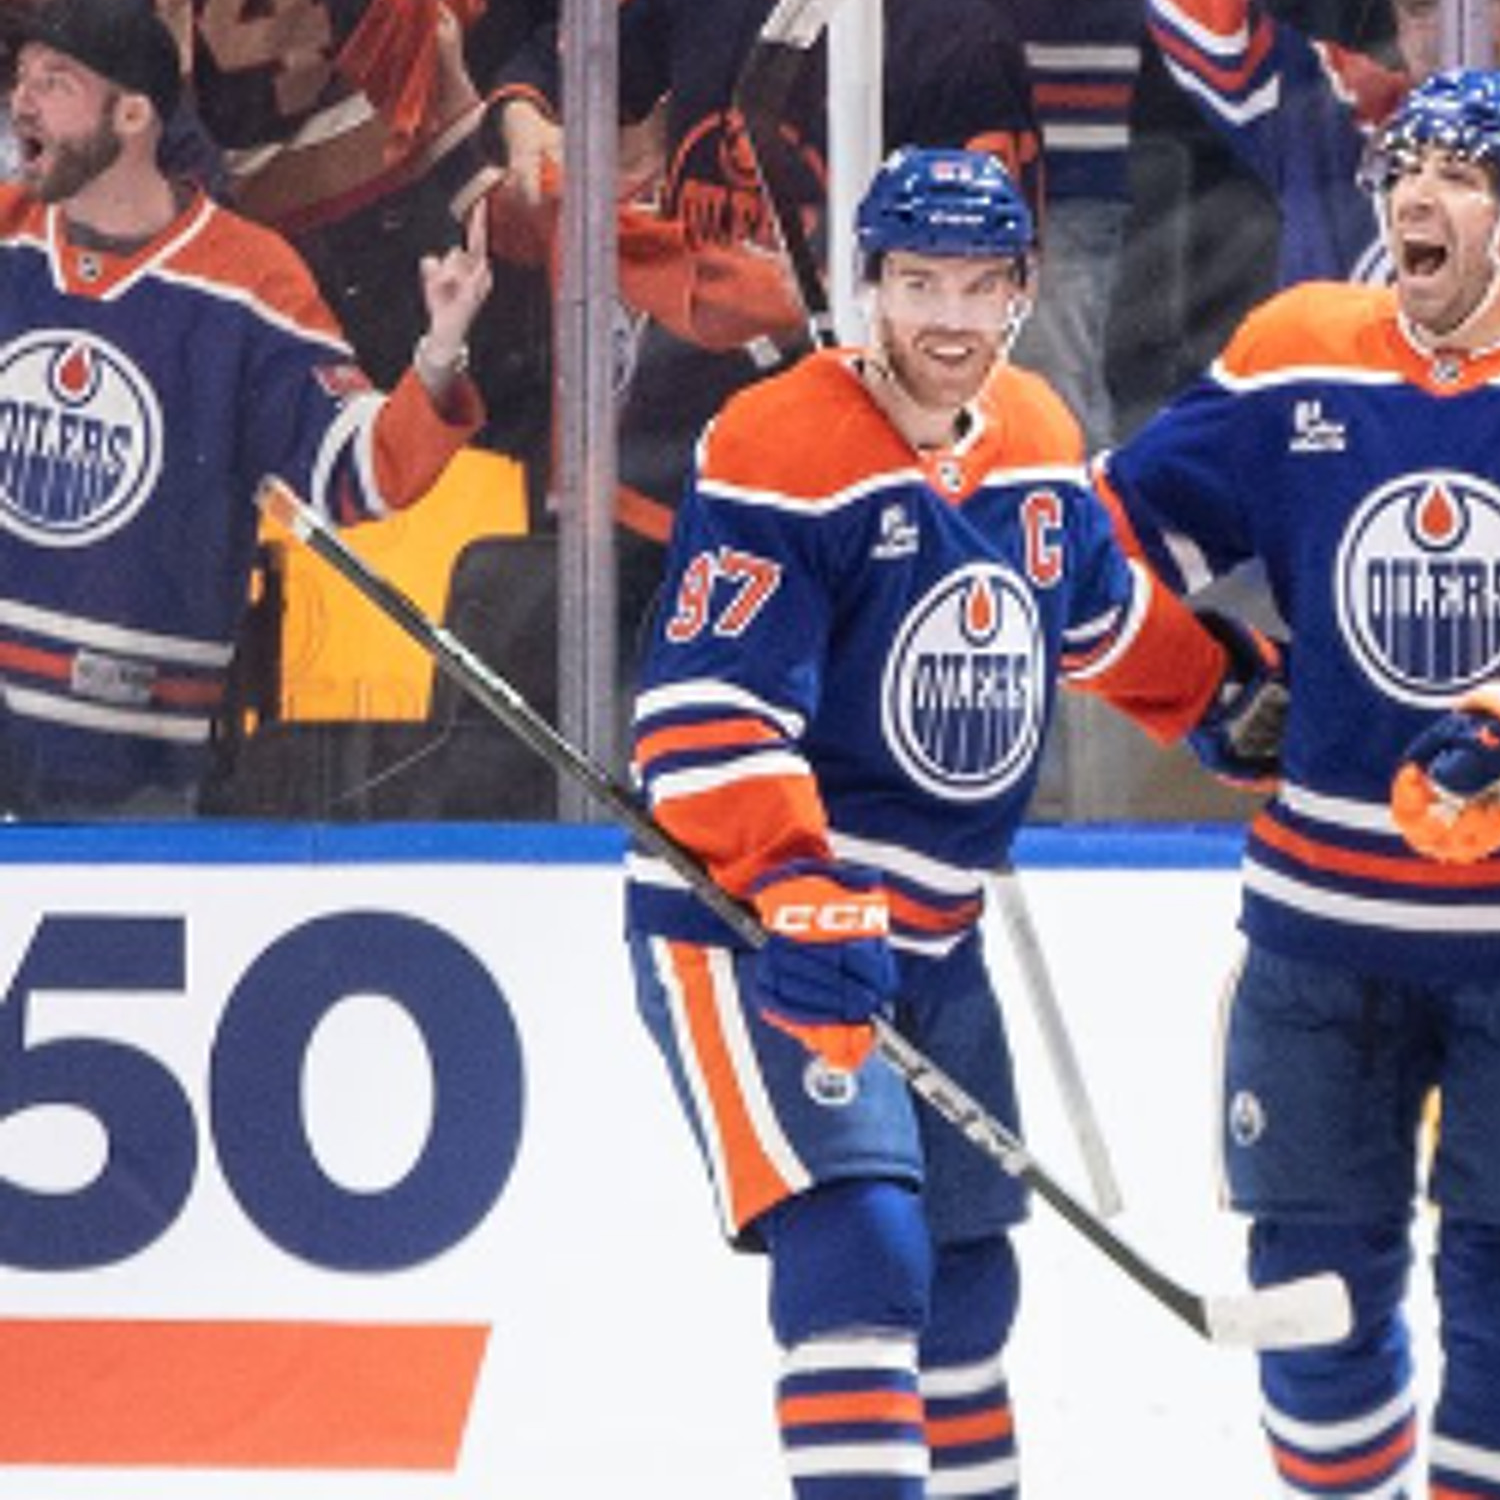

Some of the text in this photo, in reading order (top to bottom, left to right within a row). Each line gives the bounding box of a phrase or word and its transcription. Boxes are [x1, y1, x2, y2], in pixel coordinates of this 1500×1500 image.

[1019, 491, 1063, 589] C
[666, 545, 783, 642] 97
[914, 653, 1030, 710] OILERS
[0, 909, 525, 1274] 50
